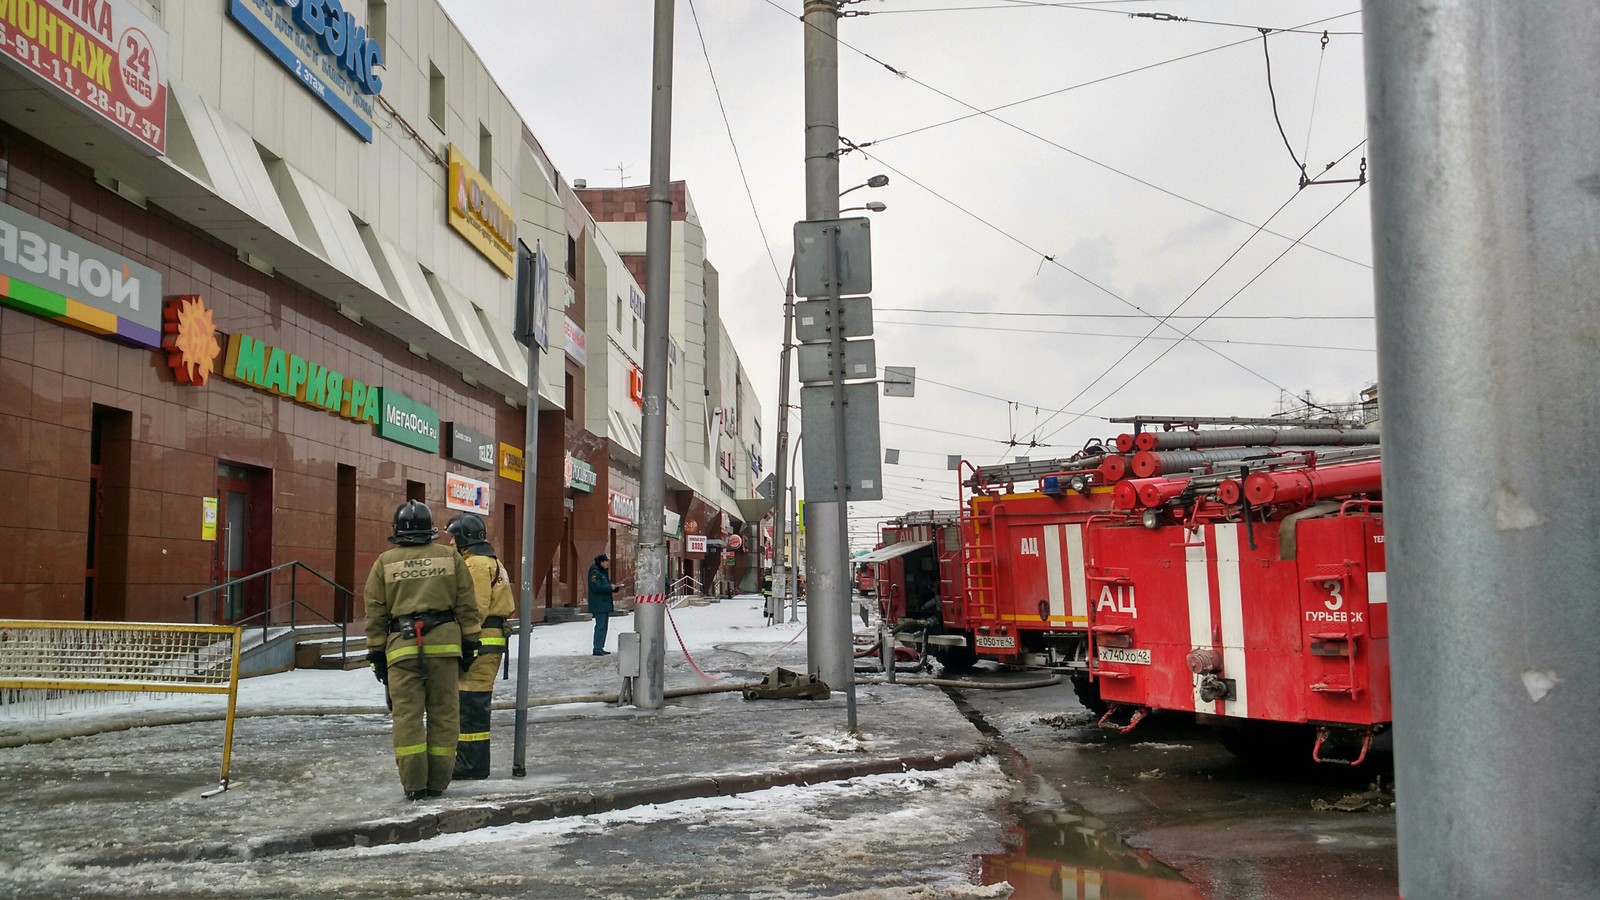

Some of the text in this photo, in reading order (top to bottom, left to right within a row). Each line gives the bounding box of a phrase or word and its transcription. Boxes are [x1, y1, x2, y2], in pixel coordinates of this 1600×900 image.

[274, 12, 294, 41] ДЛЯ
[295, 34, 311, 59] ВАС
[126, 35, 151, 82] 24
[122, 67, 152, 101] часа
[295, 59, 325, 97] 2 этаж
[86, 82, 161, 144] 28-07-37
[235, 335, 379, 424] МАРИЯ-РА
[404, 558, 432, 568] МЧС
[1021, 537, 1039, 557] АЦ
[392, 567, 446, 579] РОССИИ
[1097, 585, 1137, 619] АЦ
[1324, 580, 1343, 611] 3
[1305, 611, 1364, 622] ГУРЬЕВСК
